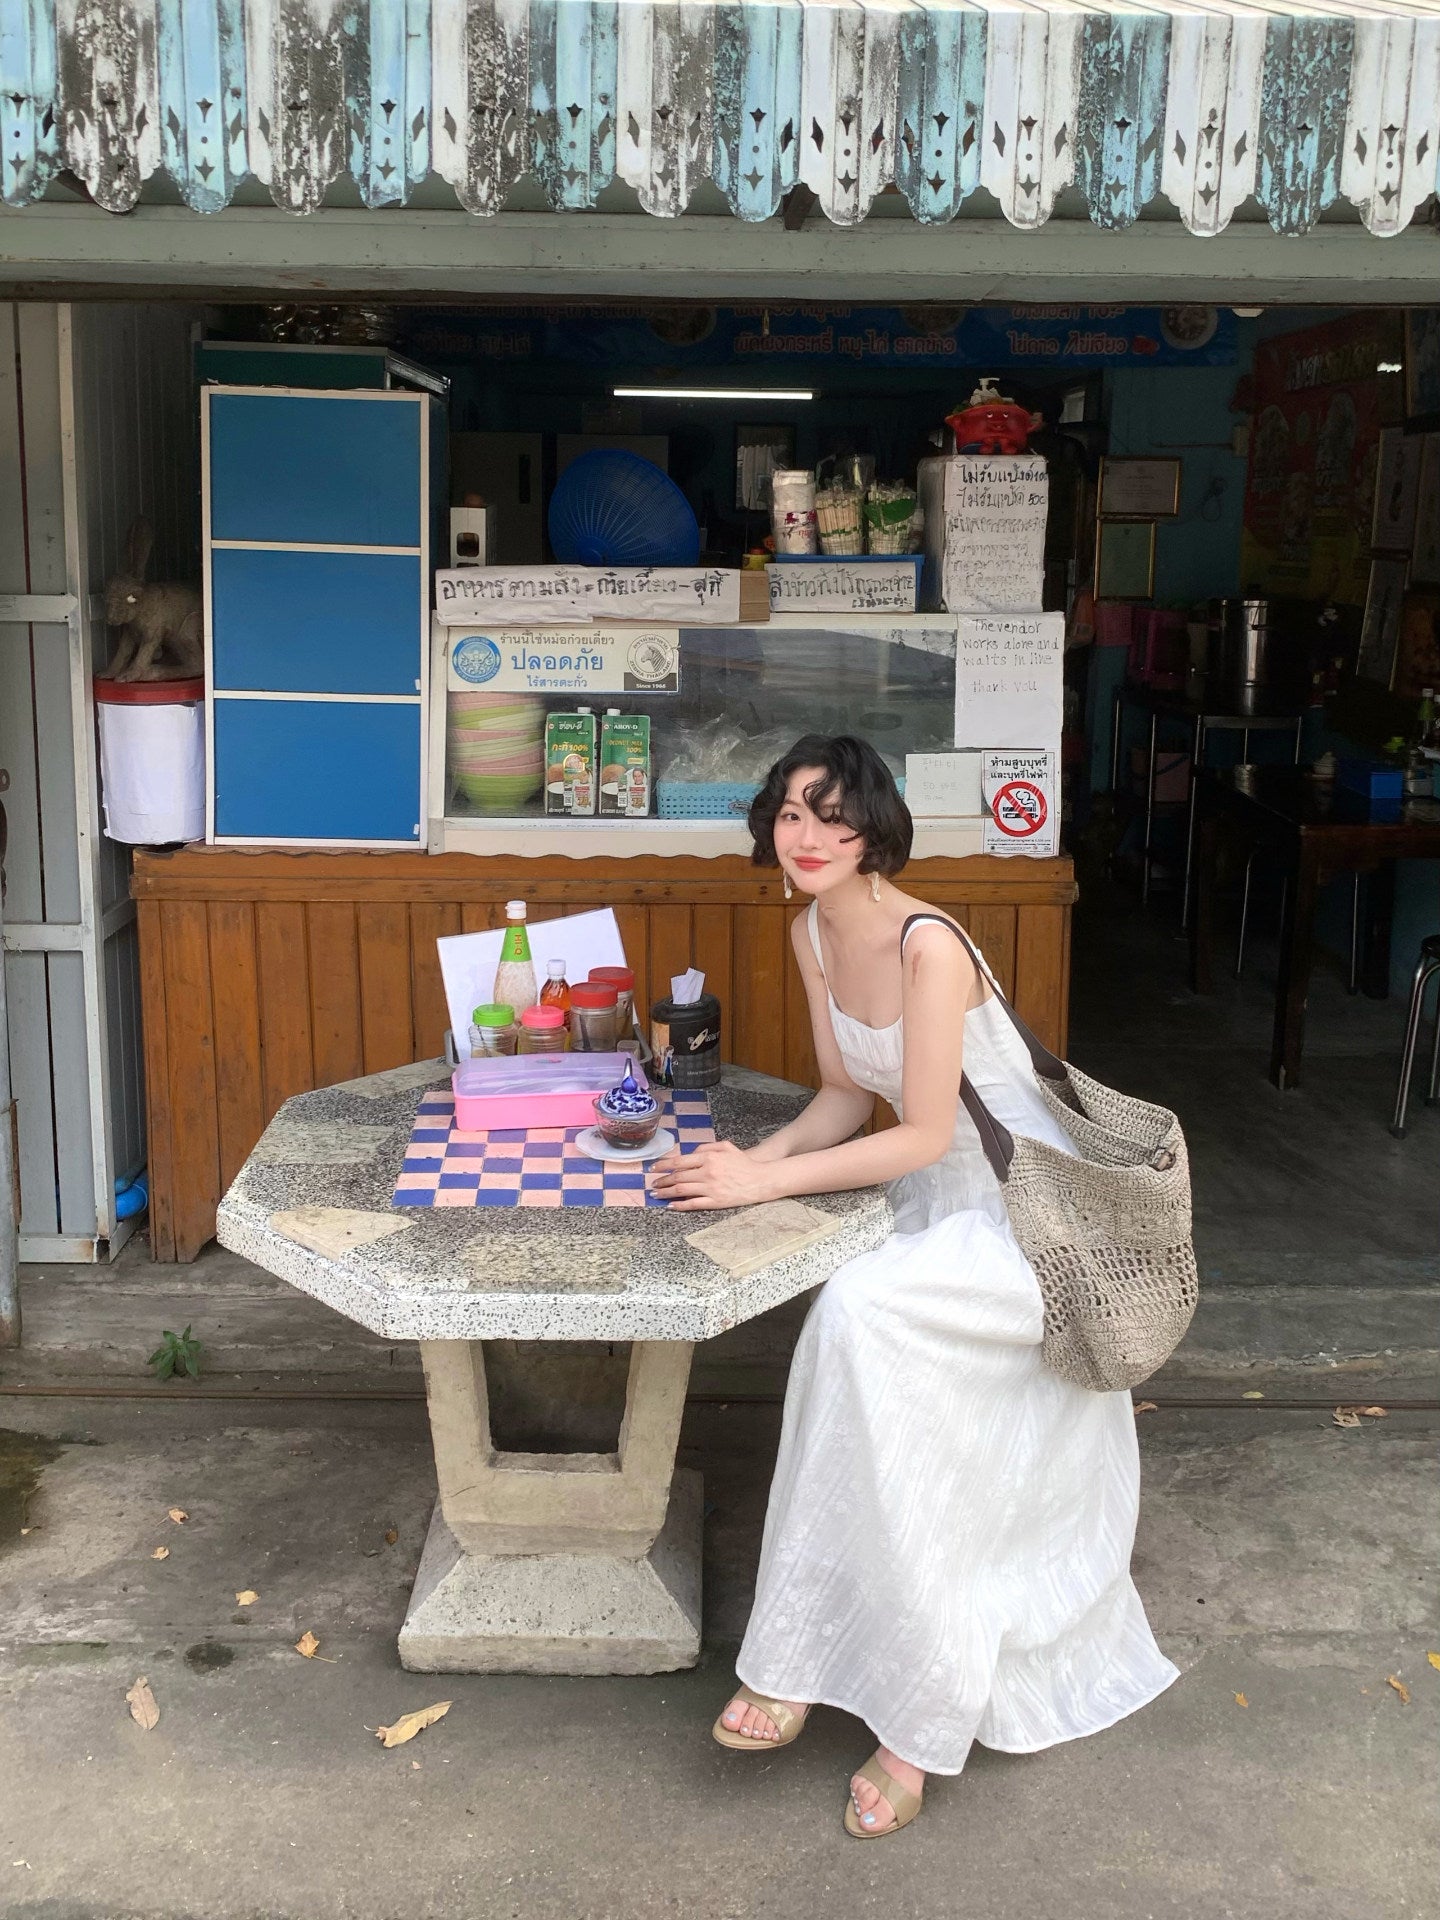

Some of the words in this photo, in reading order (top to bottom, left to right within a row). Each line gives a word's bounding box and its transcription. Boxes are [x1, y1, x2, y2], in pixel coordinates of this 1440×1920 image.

[838, 328, 889, 359] หมู-ไก่
[1006, 329, 1060, 356] ไข่ดาว
[962, 638, 999, 651] works
[1003, 636, 1034, 651] alone
[1036, 636, 1060, 651] and
[511, 646, 605, 671] ปลอดภัย
[963, 653, 1007, 667] waits
[1014, 653, 1027, 667] in
[646, 660, 672, 679] THAILAND
[527, 673, 588, 689] ไร้สารตะกั่ว
[990, 753, 1048, 770] ห้ามสูบบุหรี่
[990, 769, 1048, 782] และบุหรี่ไฟฟ้า
